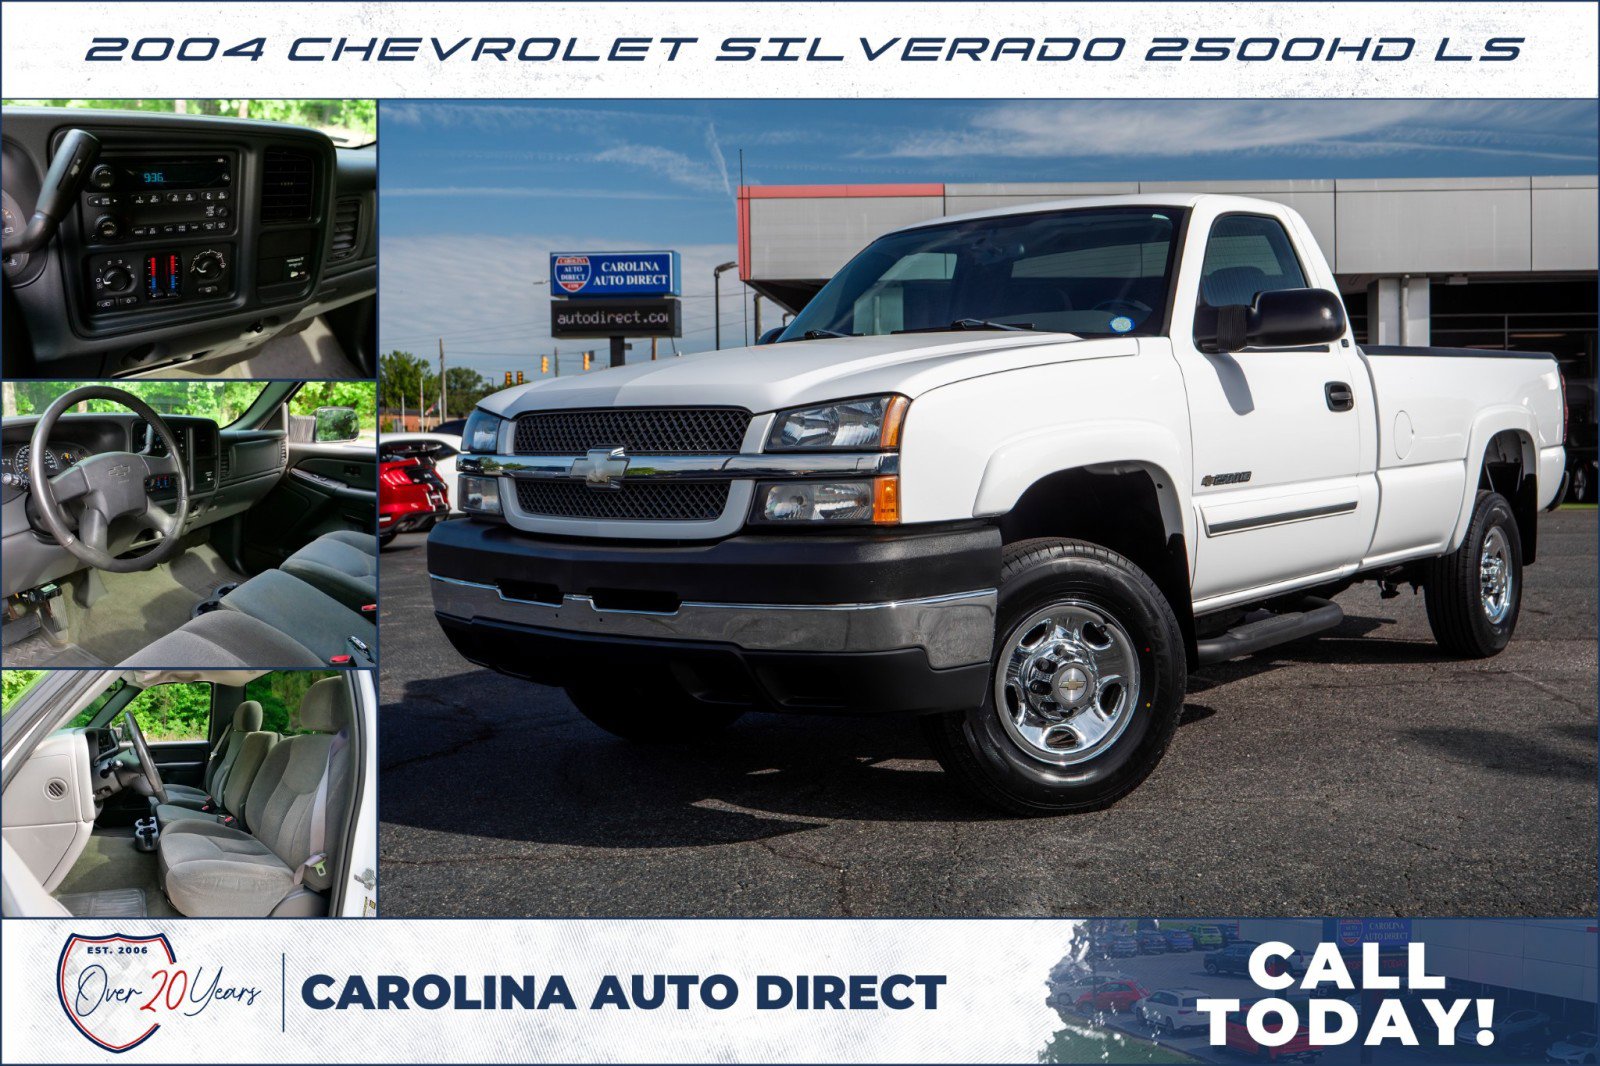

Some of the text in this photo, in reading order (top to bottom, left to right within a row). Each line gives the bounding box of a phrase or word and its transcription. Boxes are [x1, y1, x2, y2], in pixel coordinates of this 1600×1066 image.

[601, 261, 660, 272] CAROLINA
[560, 273, 586, 281] DIRECT
[593, 274, 668, 286] AUTO DIRECT
